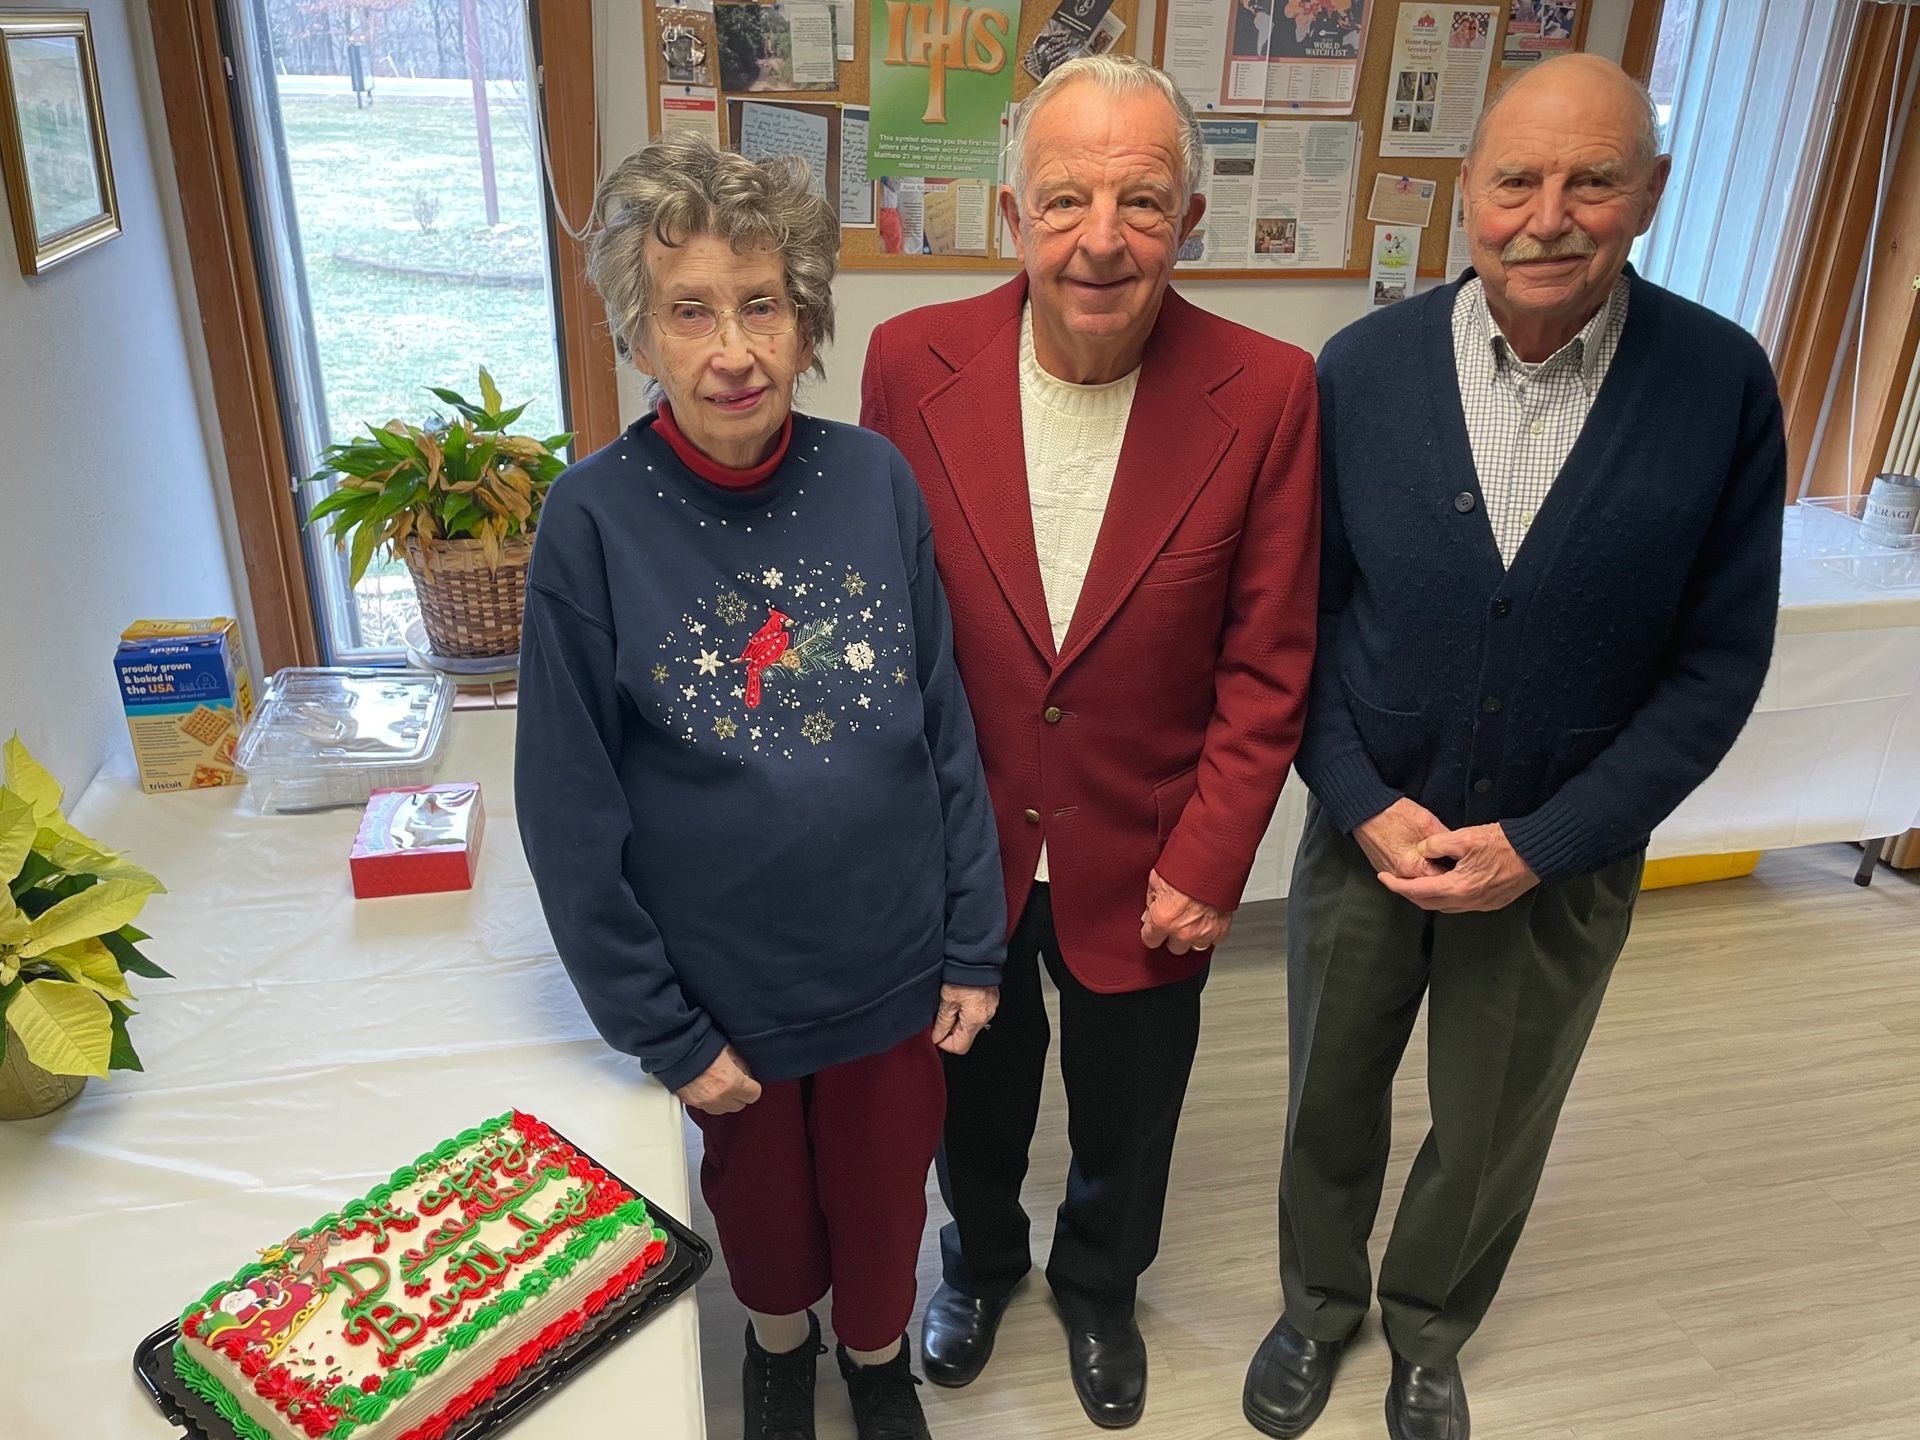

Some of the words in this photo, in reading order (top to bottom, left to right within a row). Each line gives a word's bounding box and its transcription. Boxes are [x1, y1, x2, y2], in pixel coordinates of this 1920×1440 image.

[884, 0, 1009, 75] IHS
[1313, 41, 1340, 49] WORLD
[1305, 48, 1330, 56] WATCH
[1331, 49, 1348, 57] LIST
[879, 134, 894, 142] This
[895, 136, 920, 144] symbol
[874, 151, 901, 159] Matthew
[923, 153, 938, 161] read
[937, 162, 952, 170] Lord
[121, 664, 158, 675] proudly
[160, 662, 192, 673] grown
[124, 675, 133, 684] &
[133, 674, 163, 683] baked
[165, 673, 174, 682] in
[126, 685, 146, 695] the
[148, 683, 175, 694] USA
[149, 781, 182, 790] triscuit
[341, 1138, 527, 1248] Happy
[344, 1182, 596, 1360] Birthday
